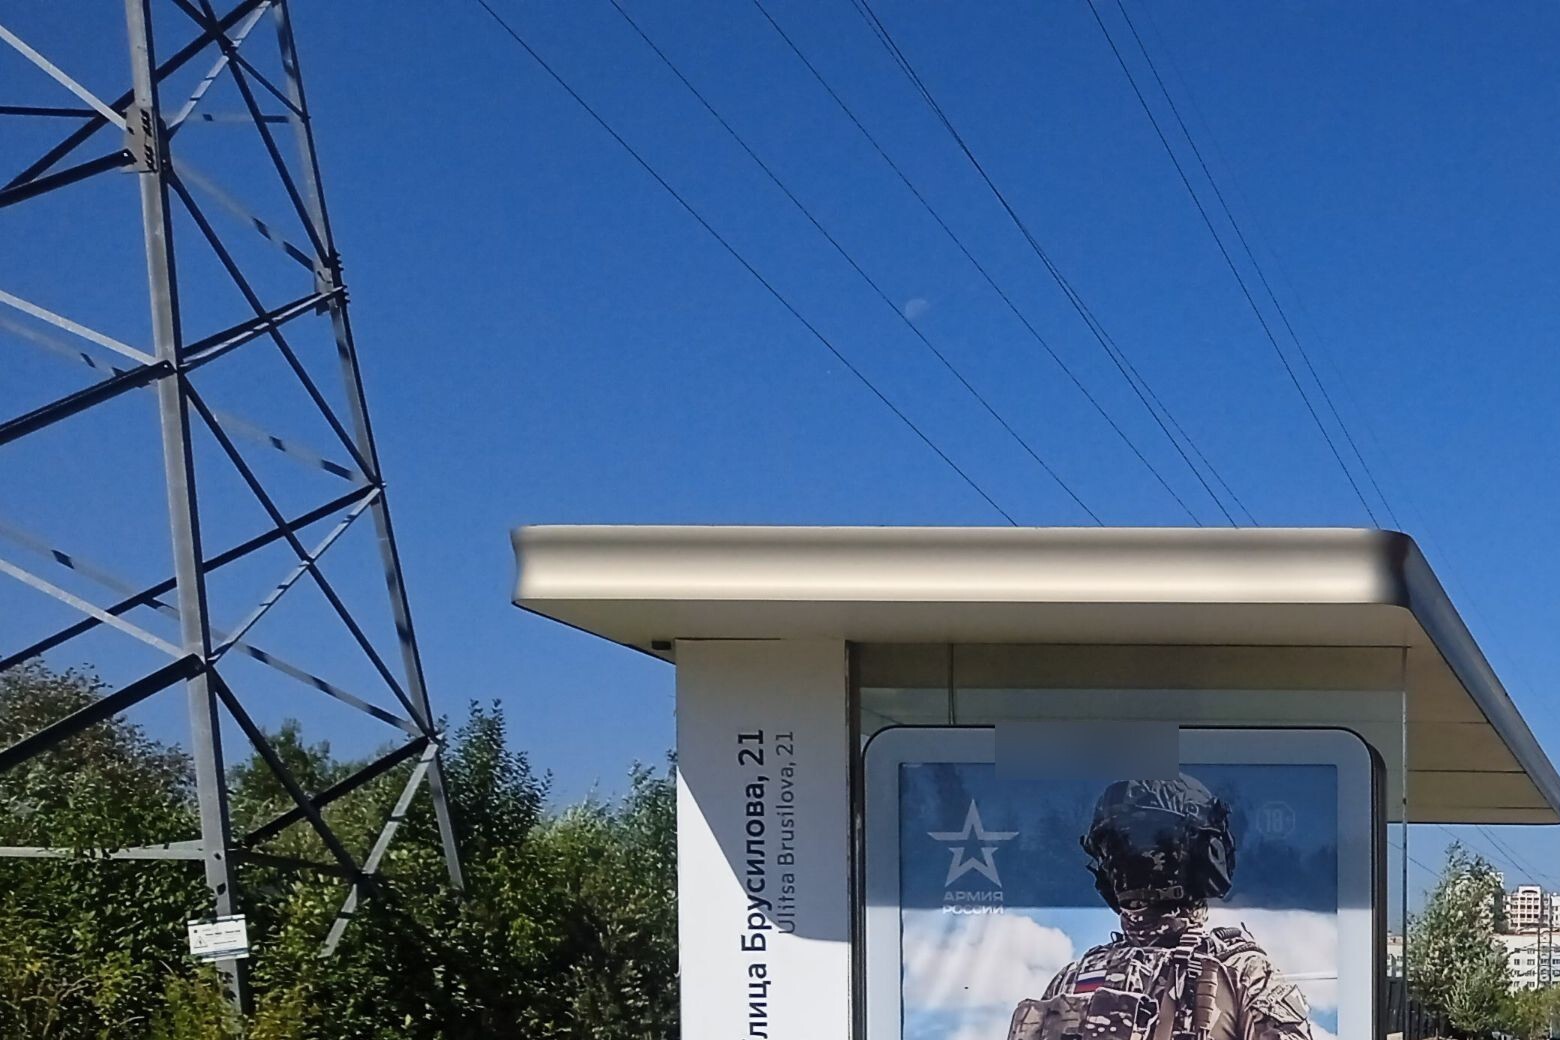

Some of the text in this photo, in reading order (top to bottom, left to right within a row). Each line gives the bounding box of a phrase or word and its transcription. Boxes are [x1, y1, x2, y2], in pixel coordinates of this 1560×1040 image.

[738, 729, 764, 766] 21
[776, 730, 797, 935] Ulitsa Brusilova, 21
[741, 775, 772, 952] Брусилова,
[942, 904, 1004, 915] РОССИИ
[944, 891, 1004, 902] АРМИЯ
